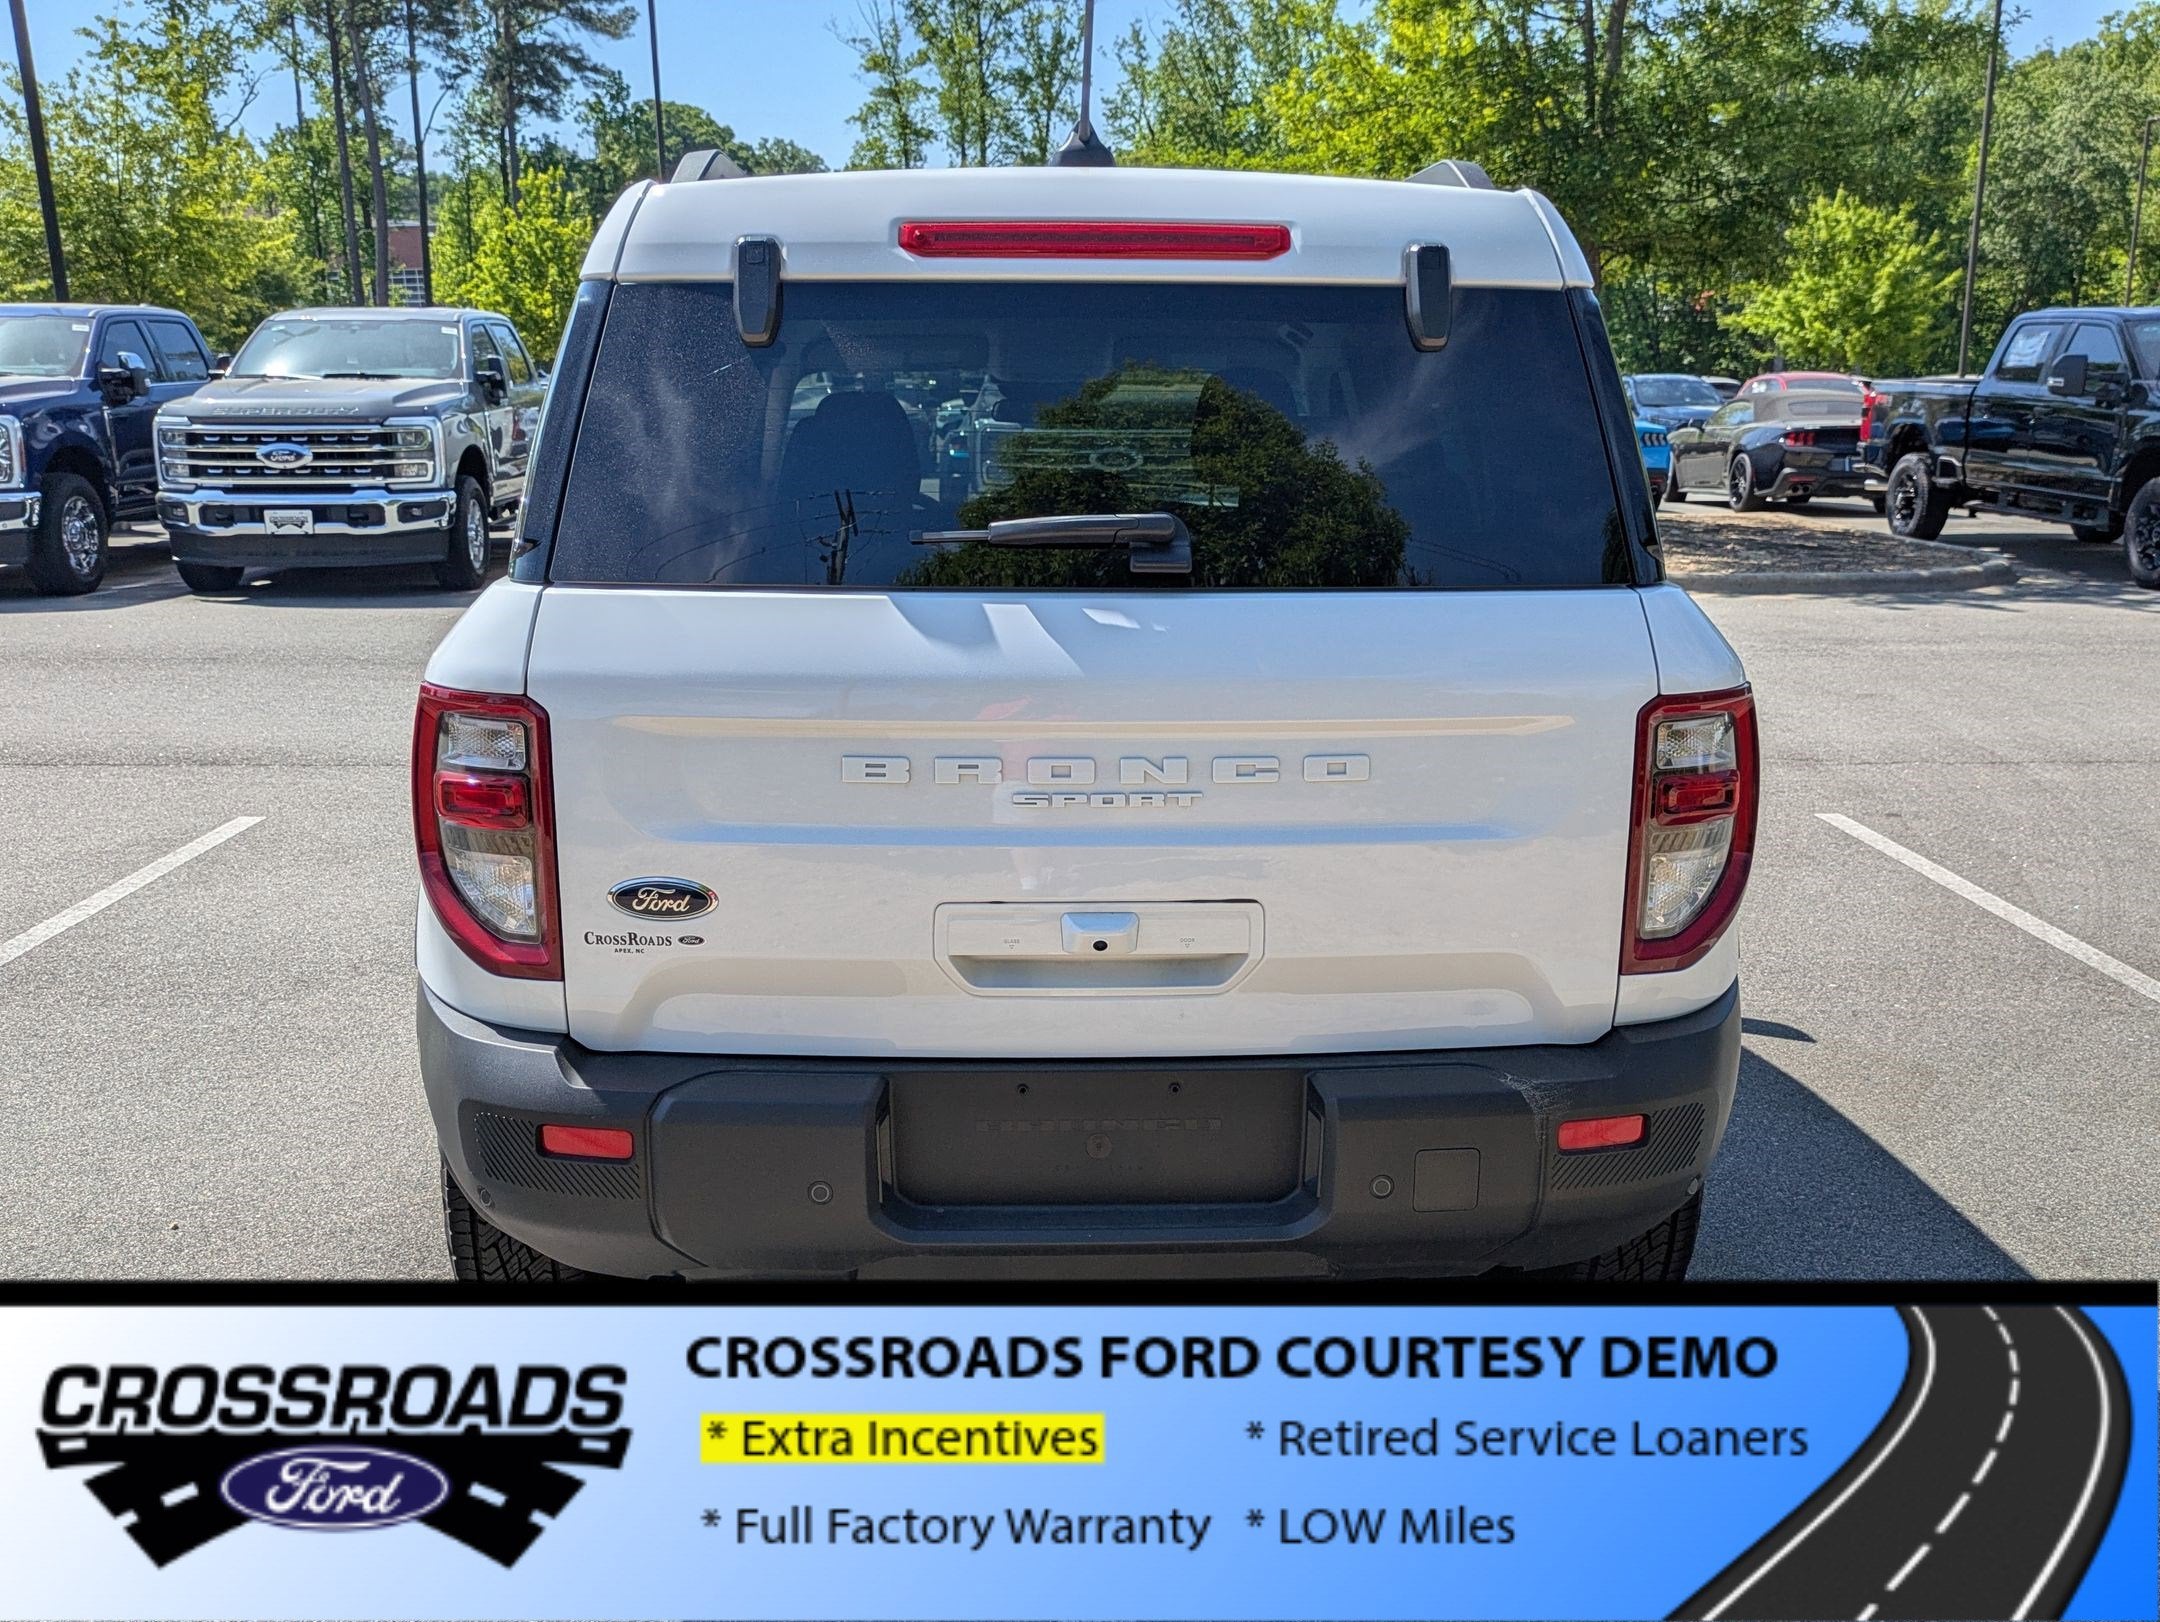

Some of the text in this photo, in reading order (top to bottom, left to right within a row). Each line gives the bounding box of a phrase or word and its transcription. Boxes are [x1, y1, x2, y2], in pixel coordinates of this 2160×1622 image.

[841, 754, 1371, 785] BRONCO
[1011, 791, 1204, 808] SPORT
[631, 886, 692, 912] Ford
